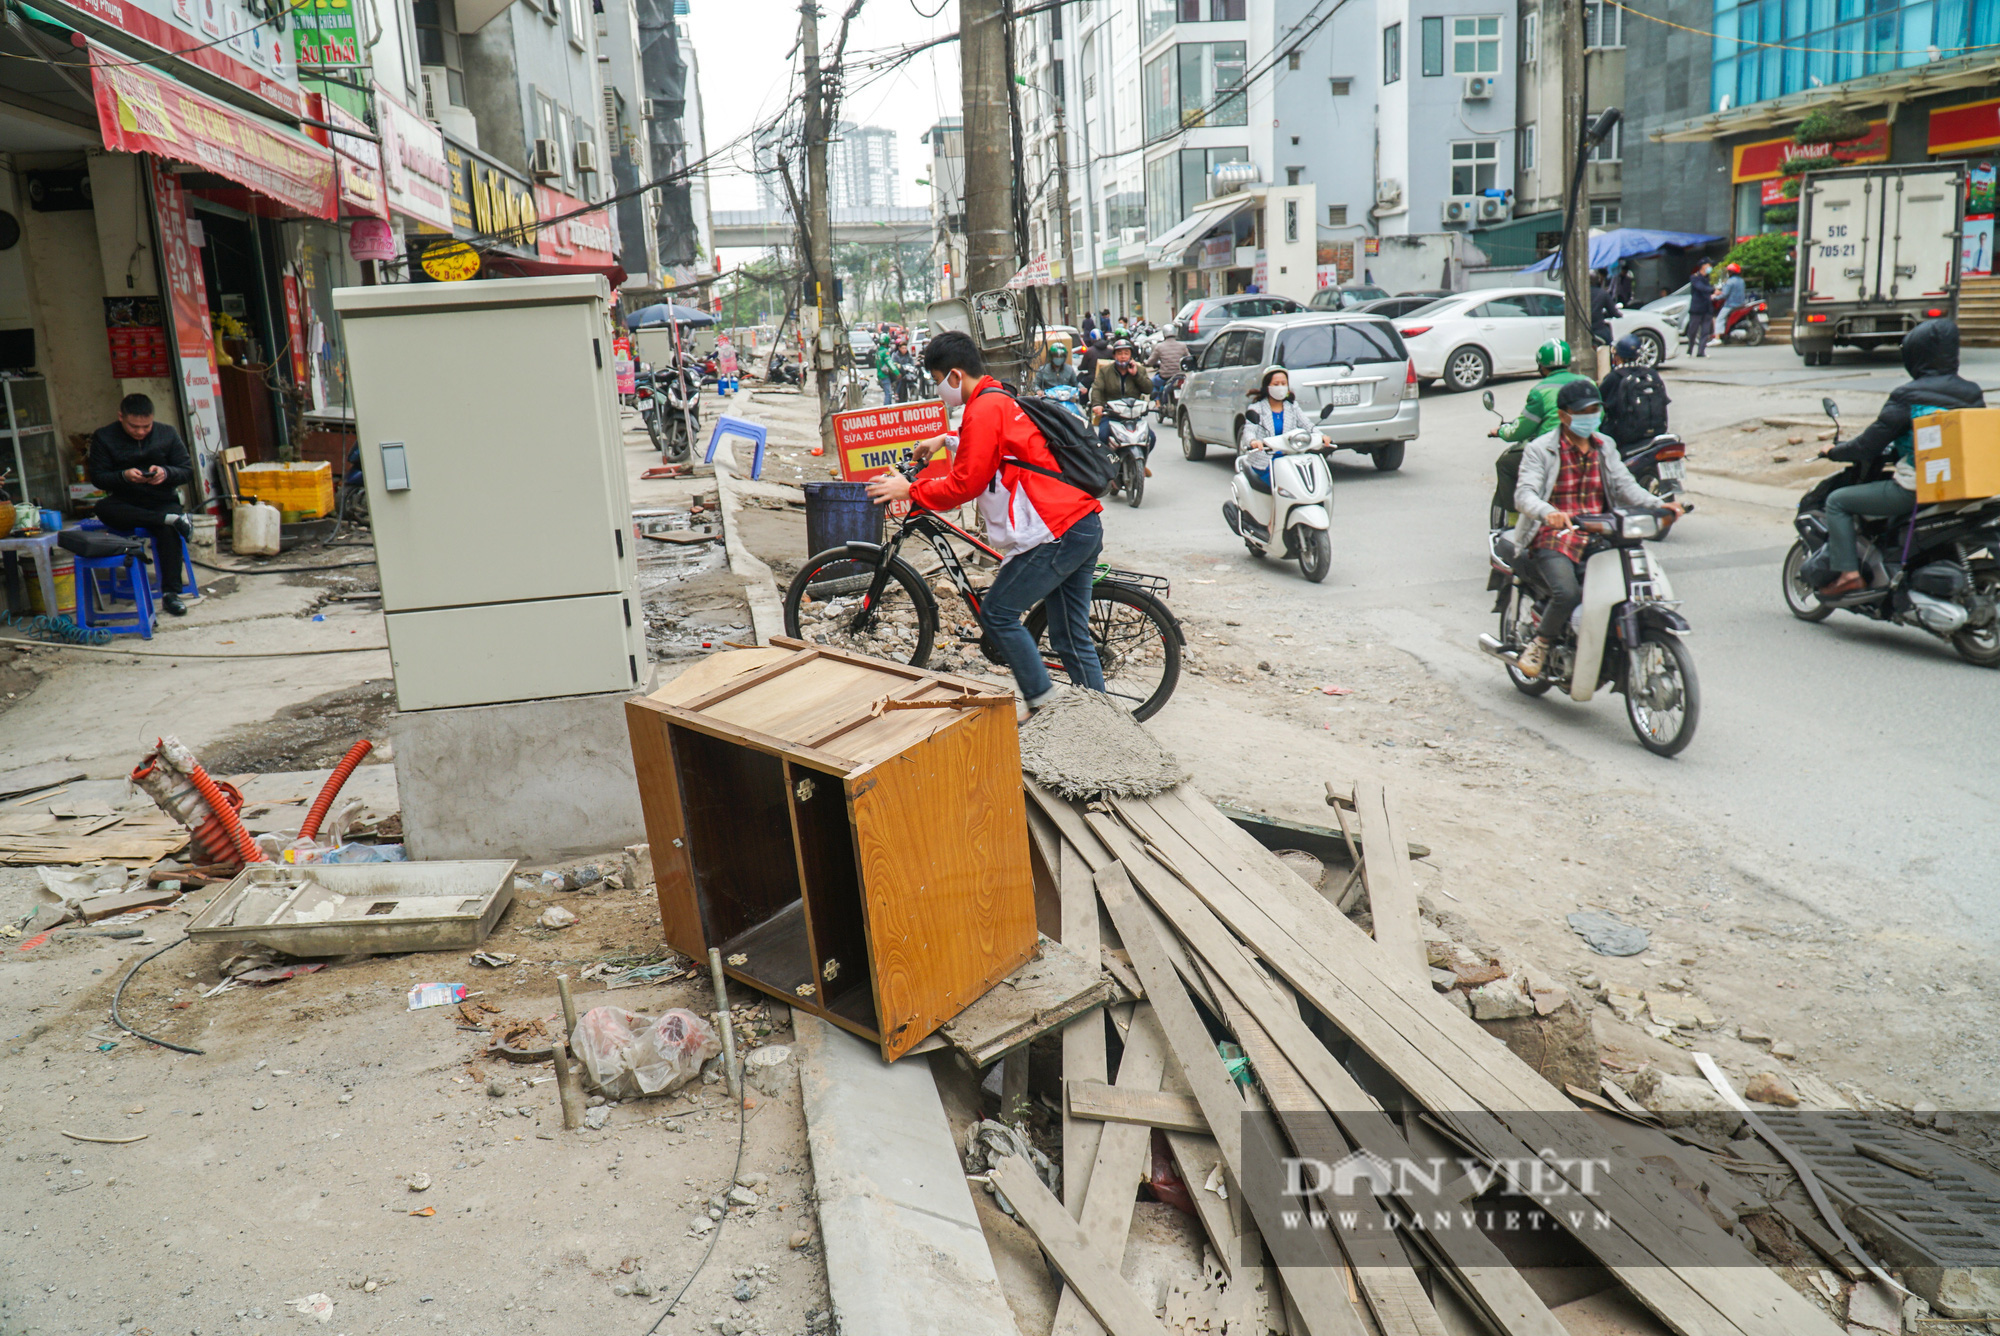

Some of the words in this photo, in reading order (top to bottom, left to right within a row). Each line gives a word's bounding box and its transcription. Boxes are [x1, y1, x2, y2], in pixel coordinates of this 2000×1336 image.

[1828, 224, 1848, 238] 51C
[192, 376, 209, 386] HONDA
[842, 415, 878, 432] QUANG
[879, 411, 900, 425] HUY
[903, 405, 940, 422] MOTOR
[863, 431, 875, 441] XE
[876, 424, 911, 439] CHUYÊN
[911, 421, 943, 434] NGHIỆP
[861, 448, 897, 468] THAY
